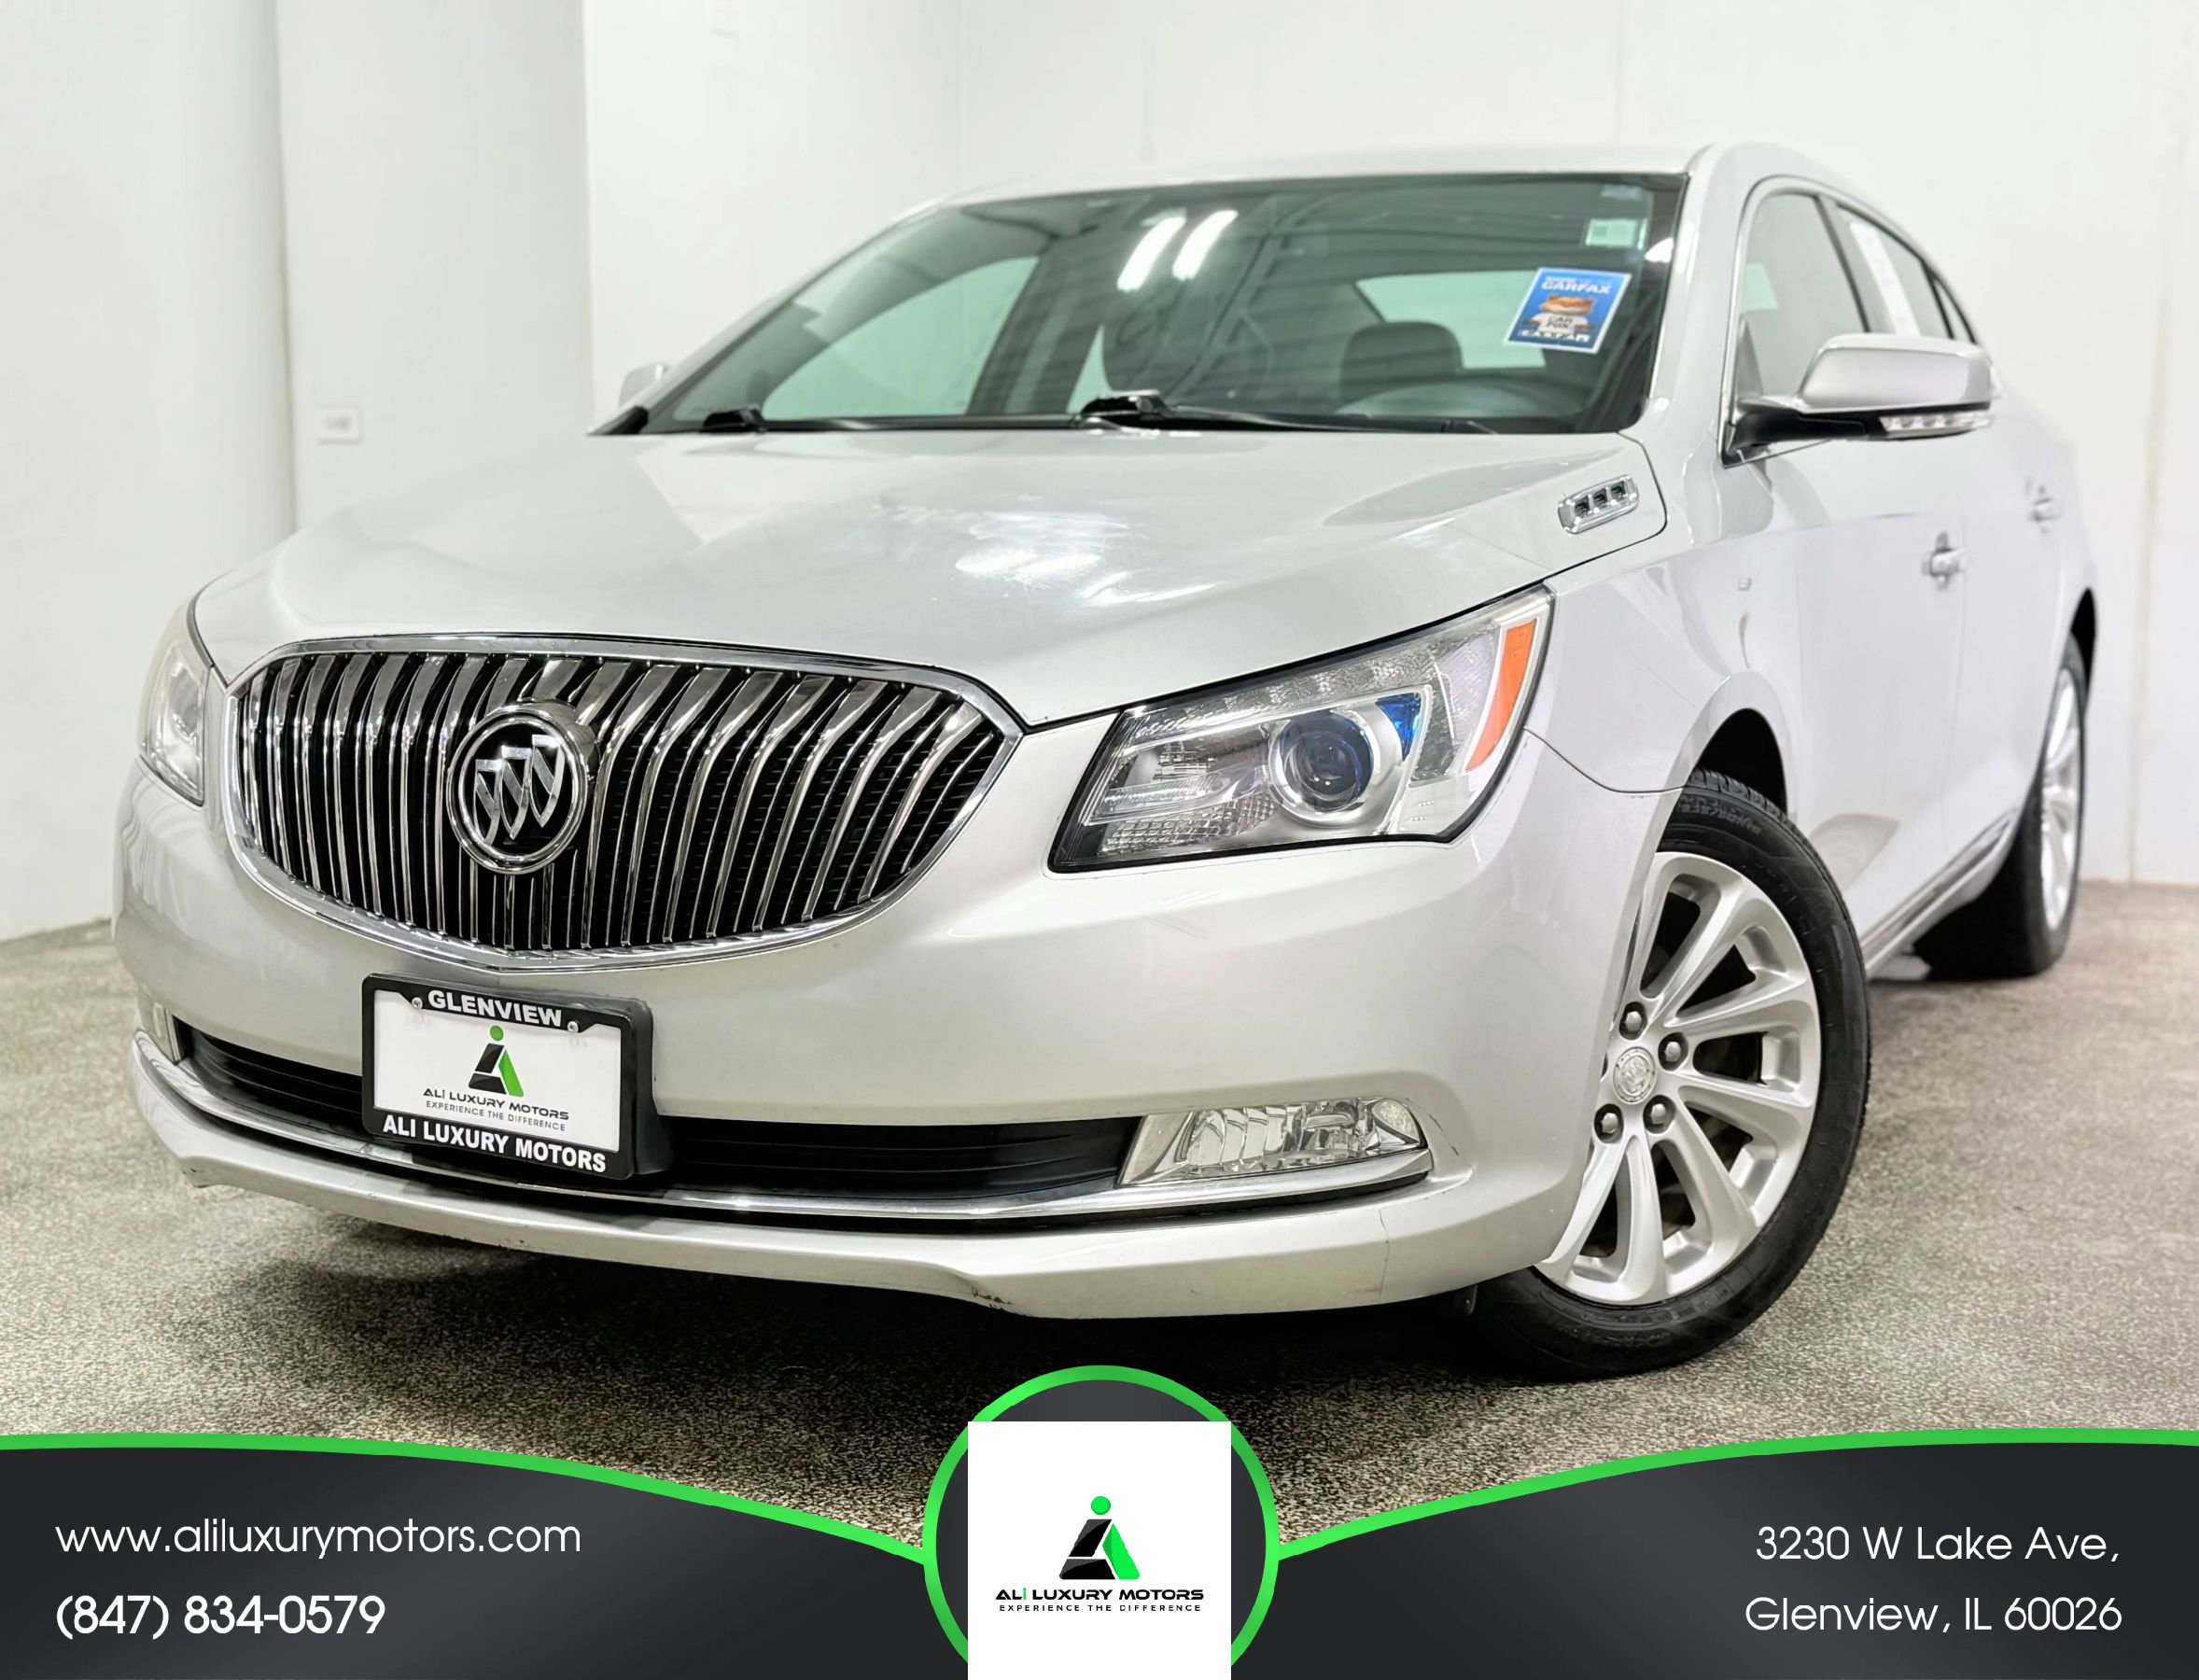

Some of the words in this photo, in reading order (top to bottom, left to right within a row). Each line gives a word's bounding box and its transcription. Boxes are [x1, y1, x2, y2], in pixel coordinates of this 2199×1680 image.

[1541, 280, 1611, 294] CARFAX
[427, 989, 562, 1027] GLENVIEW
[426, 1100, 484, 1117] EXPERIENCE
[487, 1110, 504, 1120] THE
[508, 1113, 566, 1131] DIFFERENCE
[449, 1091, 506, 1109] LUXURY
[509, 1102, 569, 1121] MOTORS
[383, 1114, 415, 1138] ALI
[423, 1121, 509, 1154] LUXURY
[515, 1139, 607, 1173] MOTORS
